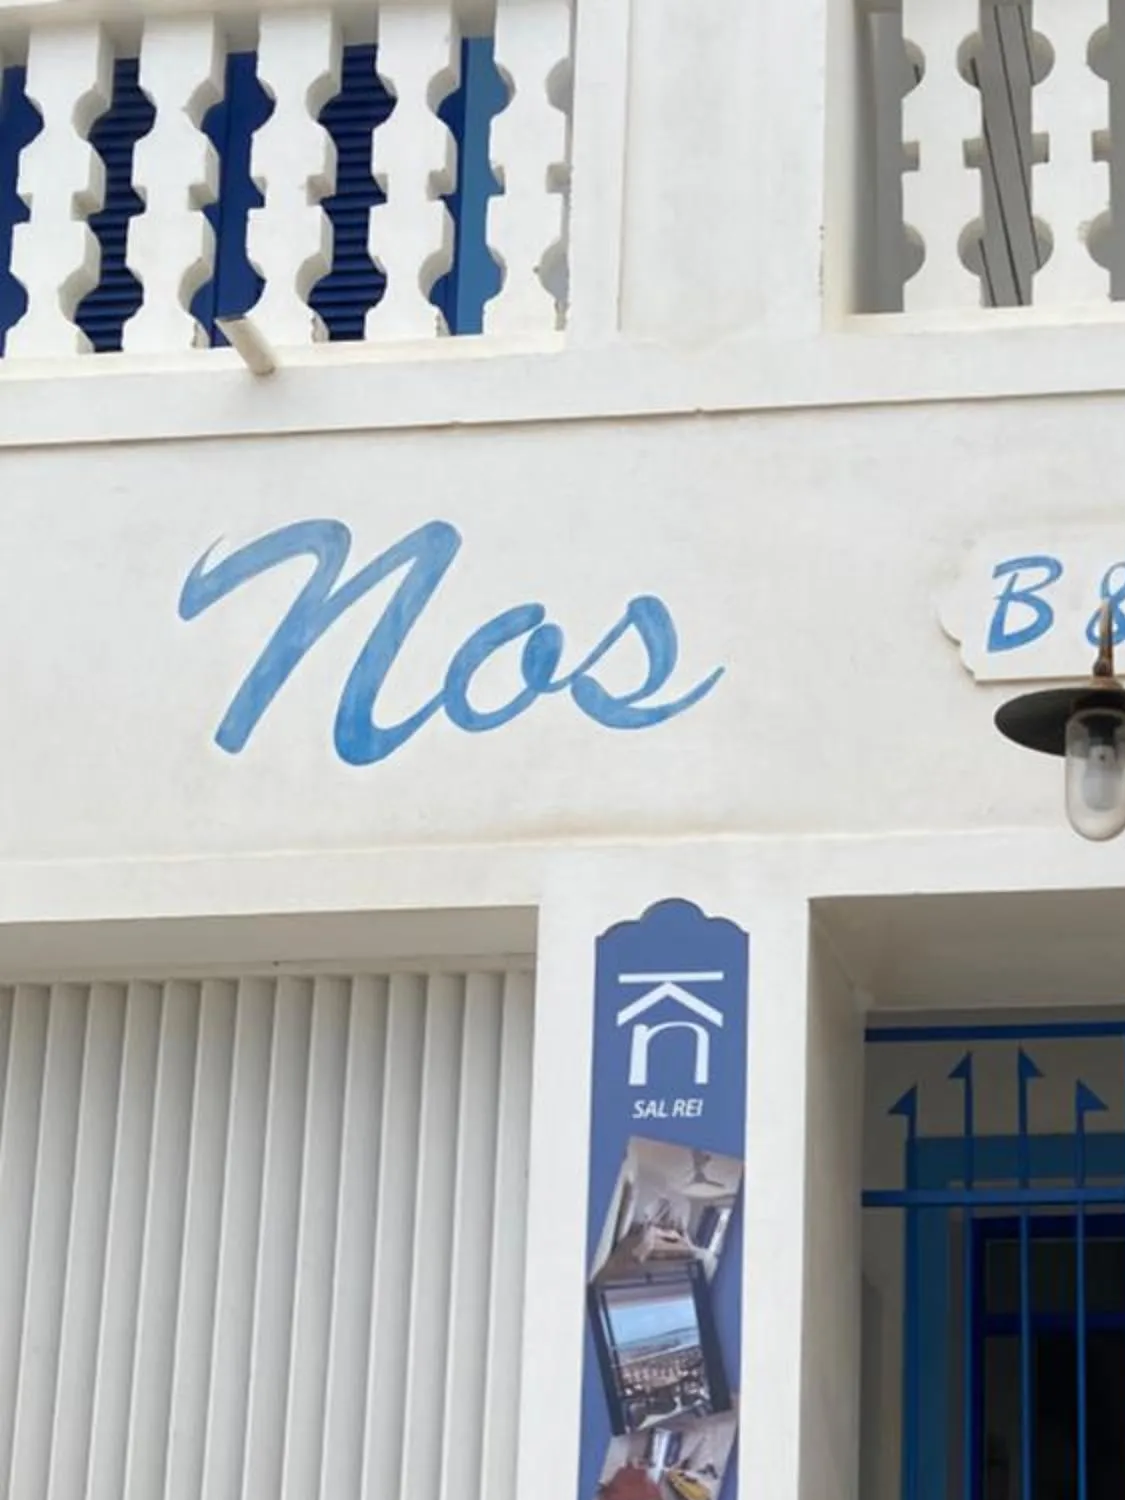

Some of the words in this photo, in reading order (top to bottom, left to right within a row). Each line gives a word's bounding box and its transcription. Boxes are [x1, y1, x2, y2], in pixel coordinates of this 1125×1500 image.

[178, 518, 725, 766] Nos
[632, 1099, 669, 1119] SAL
[672, 1098, 704, 1118] REI
